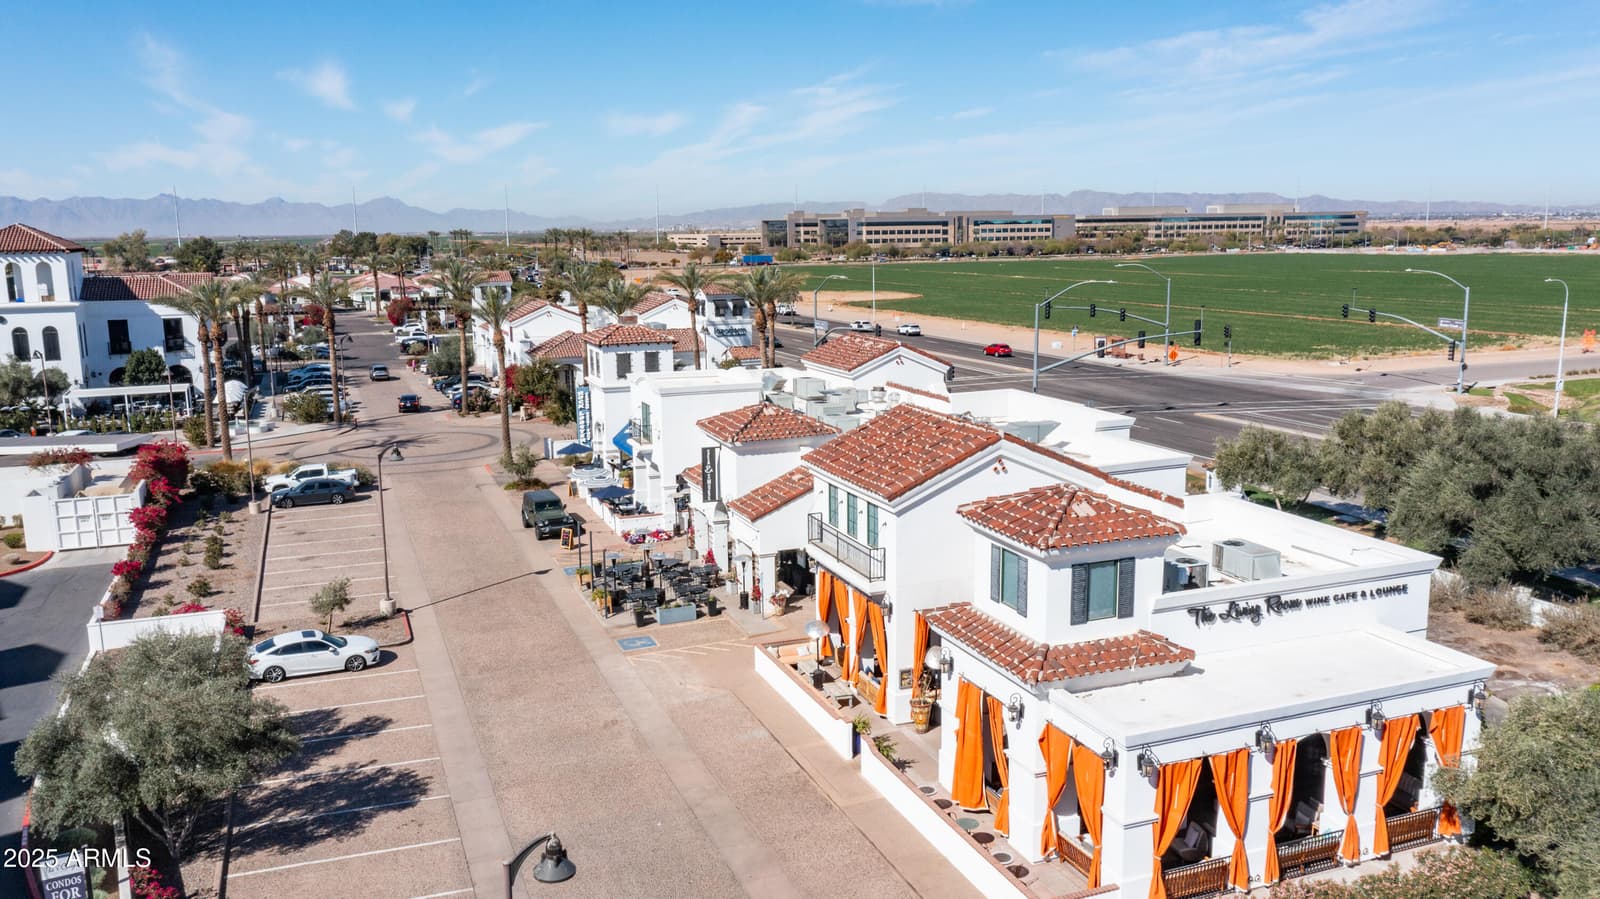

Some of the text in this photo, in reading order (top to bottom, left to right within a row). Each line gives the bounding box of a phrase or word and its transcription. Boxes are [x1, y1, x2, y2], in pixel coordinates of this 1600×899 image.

[1187, 605, 1217, 628] The
[1218, 601, 1264, 625] Living
[1264, 595, 1303, 616] Room
[1305, 595, 1331, 608] WINE
[1333, 591, 1358, 604] CAFE
[1369, 584, 1409, 600] LOUNGE
[46, 875, 82, 891] CONDOS
[51, 886, 82, 899] FOR
